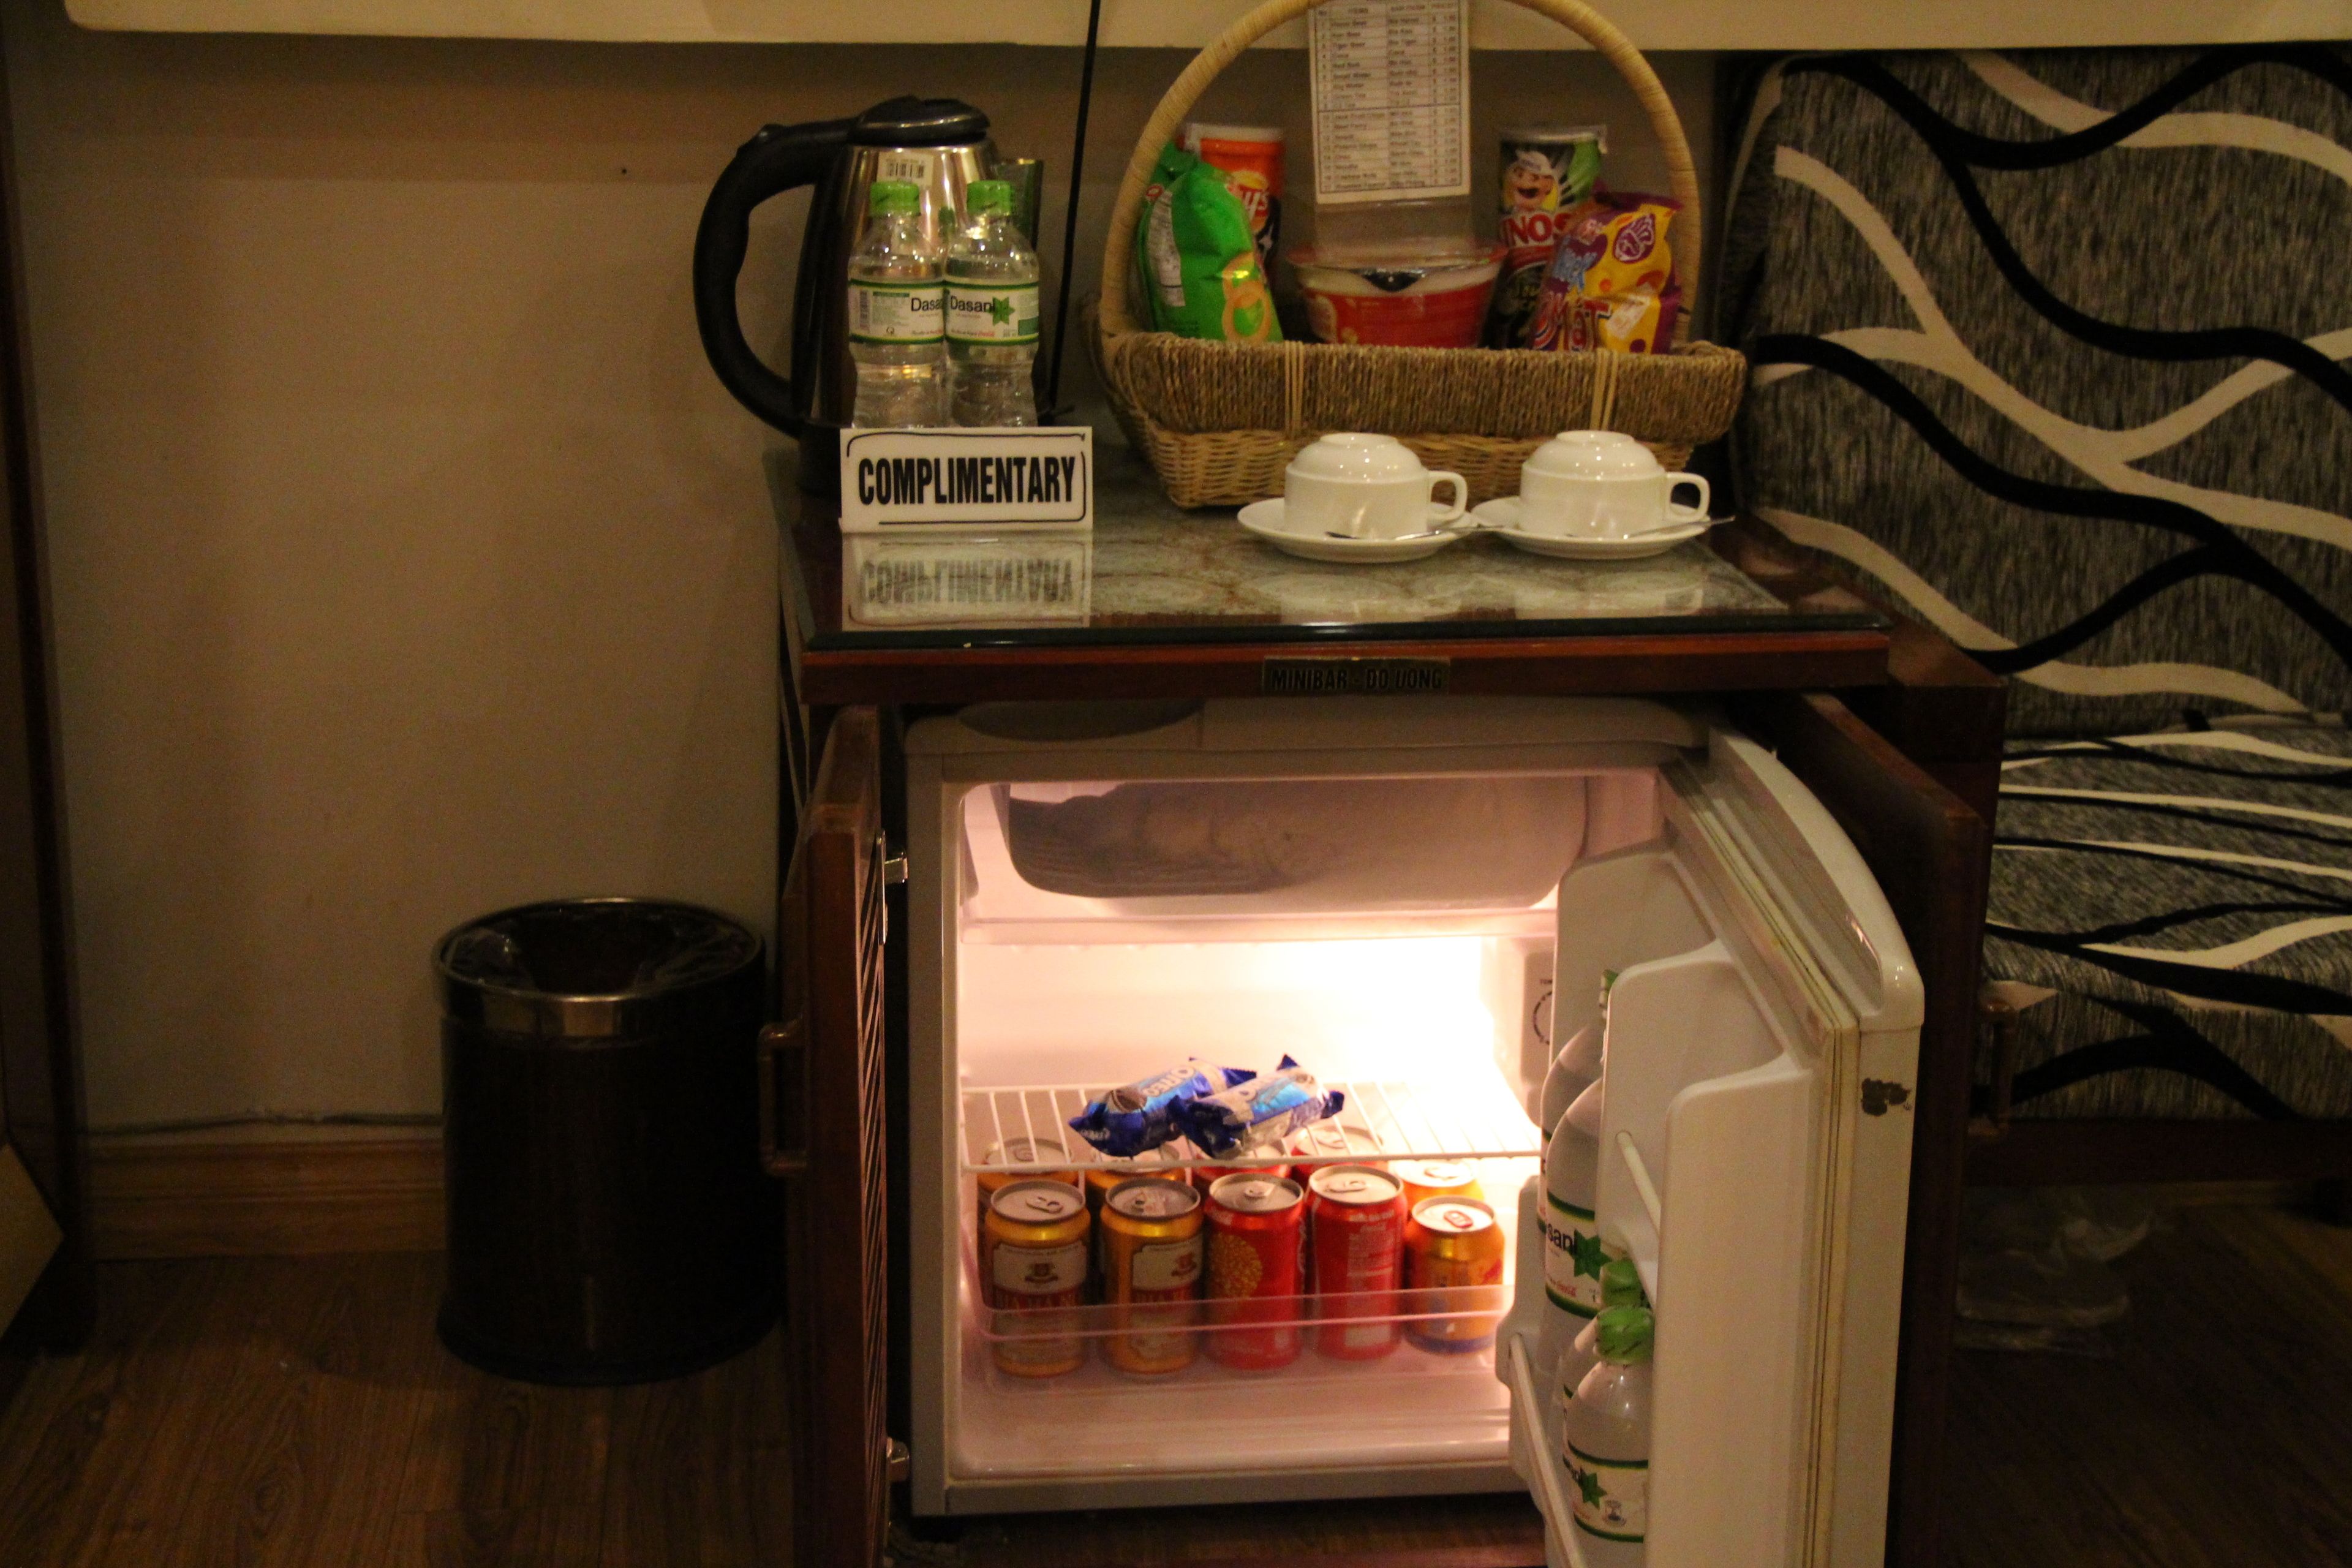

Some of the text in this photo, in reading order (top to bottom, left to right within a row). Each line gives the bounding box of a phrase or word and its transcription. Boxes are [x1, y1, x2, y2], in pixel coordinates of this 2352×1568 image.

[950, 295, 995, 313] Dasani
[858, 456, 1076, 505] COMPLIMENTARY
[1271, 668, 1347, 690] MINIBAR
